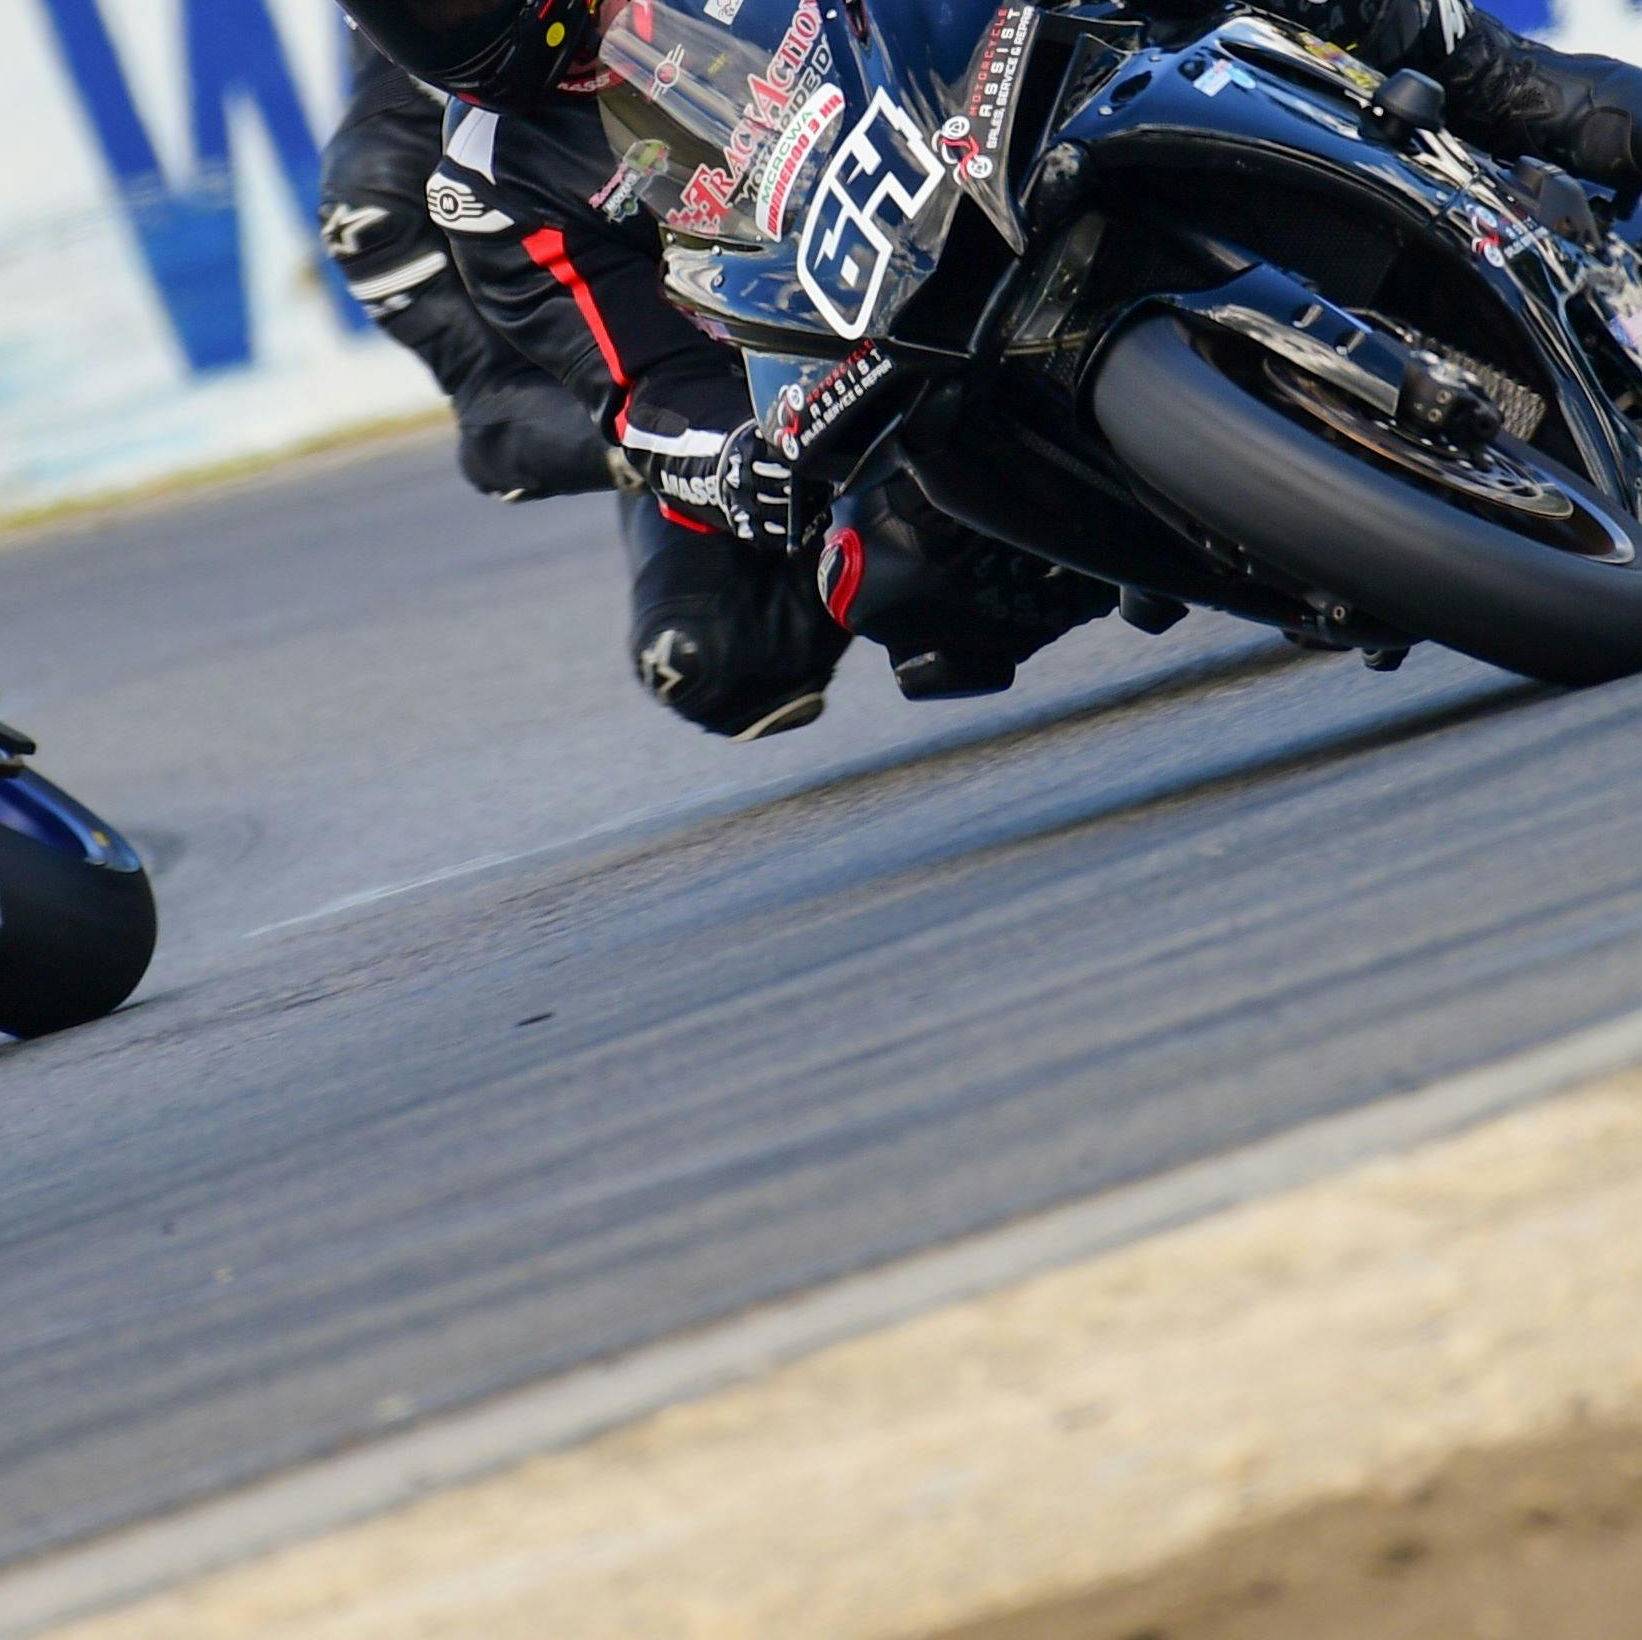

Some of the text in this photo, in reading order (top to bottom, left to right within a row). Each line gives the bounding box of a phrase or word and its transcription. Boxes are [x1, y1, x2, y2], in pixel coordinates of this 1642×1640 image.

[979, 8, 1020, 117] ASSIST
[996, 57, 1018, 106] SERVICE
[761, 109, 814, 205] MCRCWA
[810, 348, 882, 420] ASSIST
